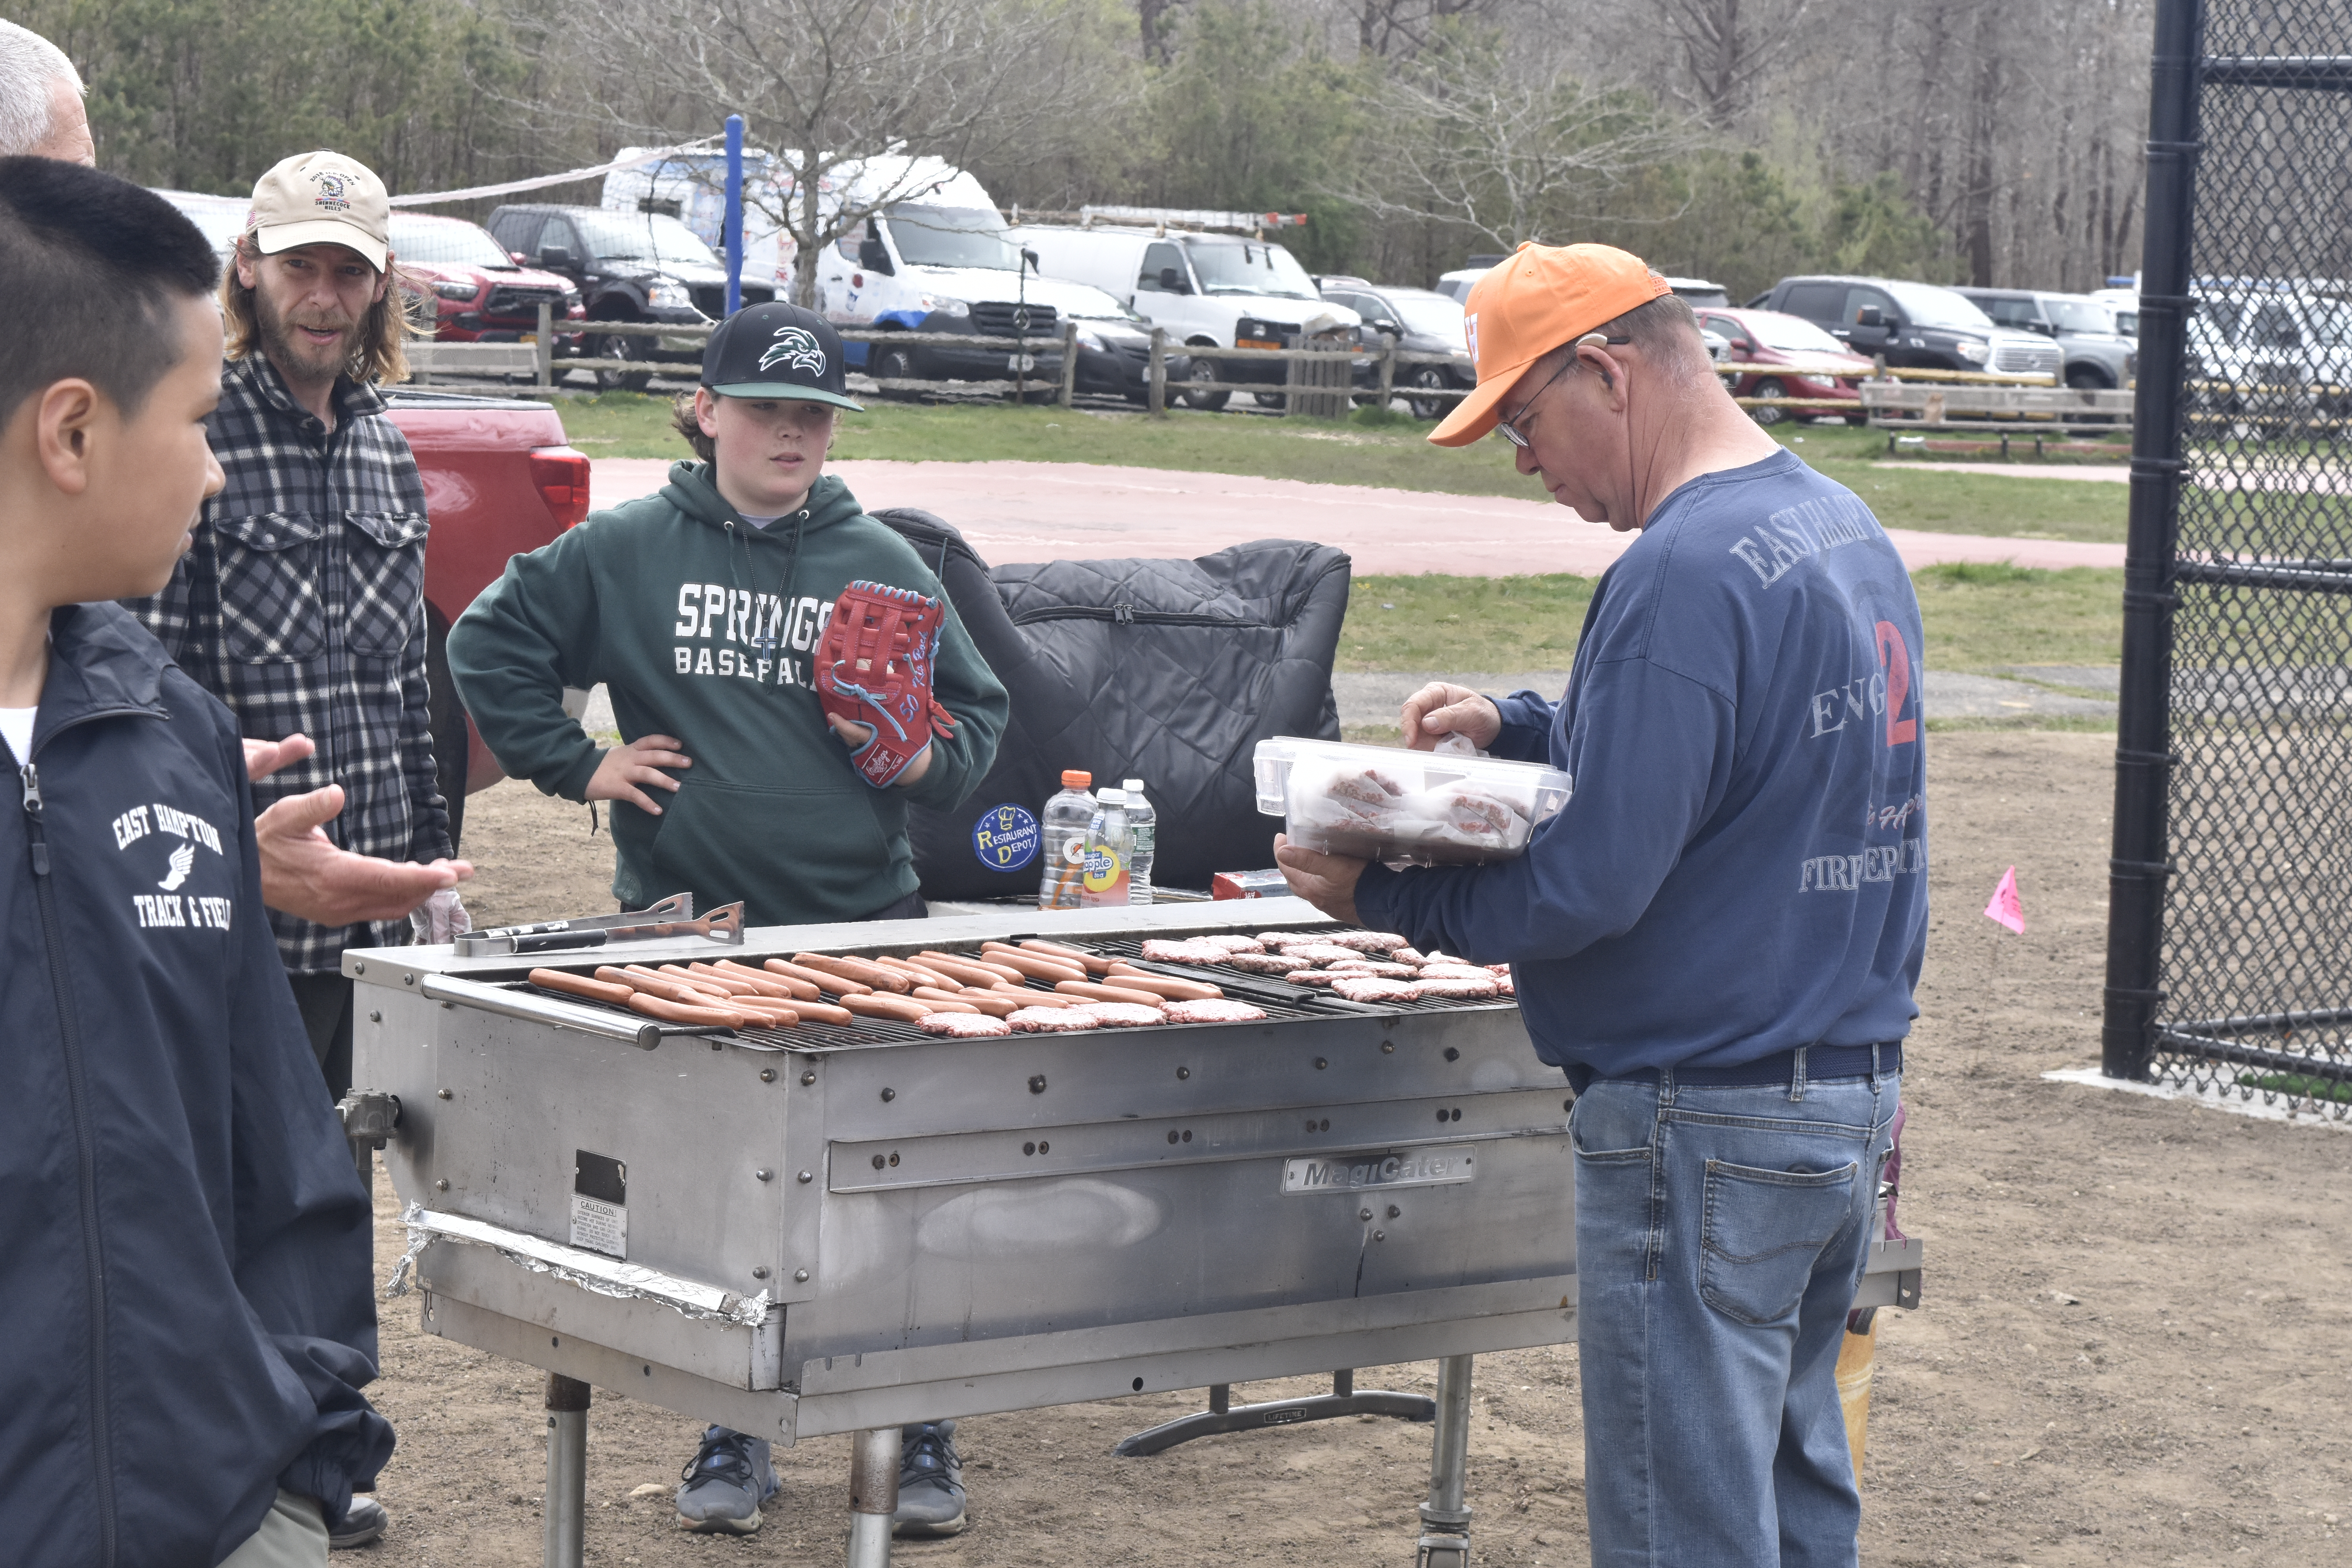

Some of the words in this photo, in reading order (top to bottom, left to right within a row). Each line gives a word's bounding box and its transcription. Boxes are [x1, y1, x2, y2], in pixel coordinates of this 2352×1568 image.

[310, 172, 324, 182] 2018
[339, 174, 356, 185] OPEN
[315, 200, 350, 209] SHINNECOCK
[1729, 503, 1821, 590] EAST
[674, 647, 817, 692] BASEBAL
[1875, 620, 1916, 747] 2
[900, 693, 919, 722] 50
[866, 750, 890, 776] Rawlings
[112, 805, 151, 851] EAST
[153, 803, 223, 855] HAMPTON
[977, 824, 1036, 849] RESTAURANT
[998, 838, 1032, 864] DEPOT
[133, 895, 186, 927] TRACK
[188, 896, 201, 927] &
[1303, 1155, 1459, 1188] MagiCater
[581, 1201, 617, 1216] CAUTION!
[1269, 1410, 1301, 1421] LIFETIME
